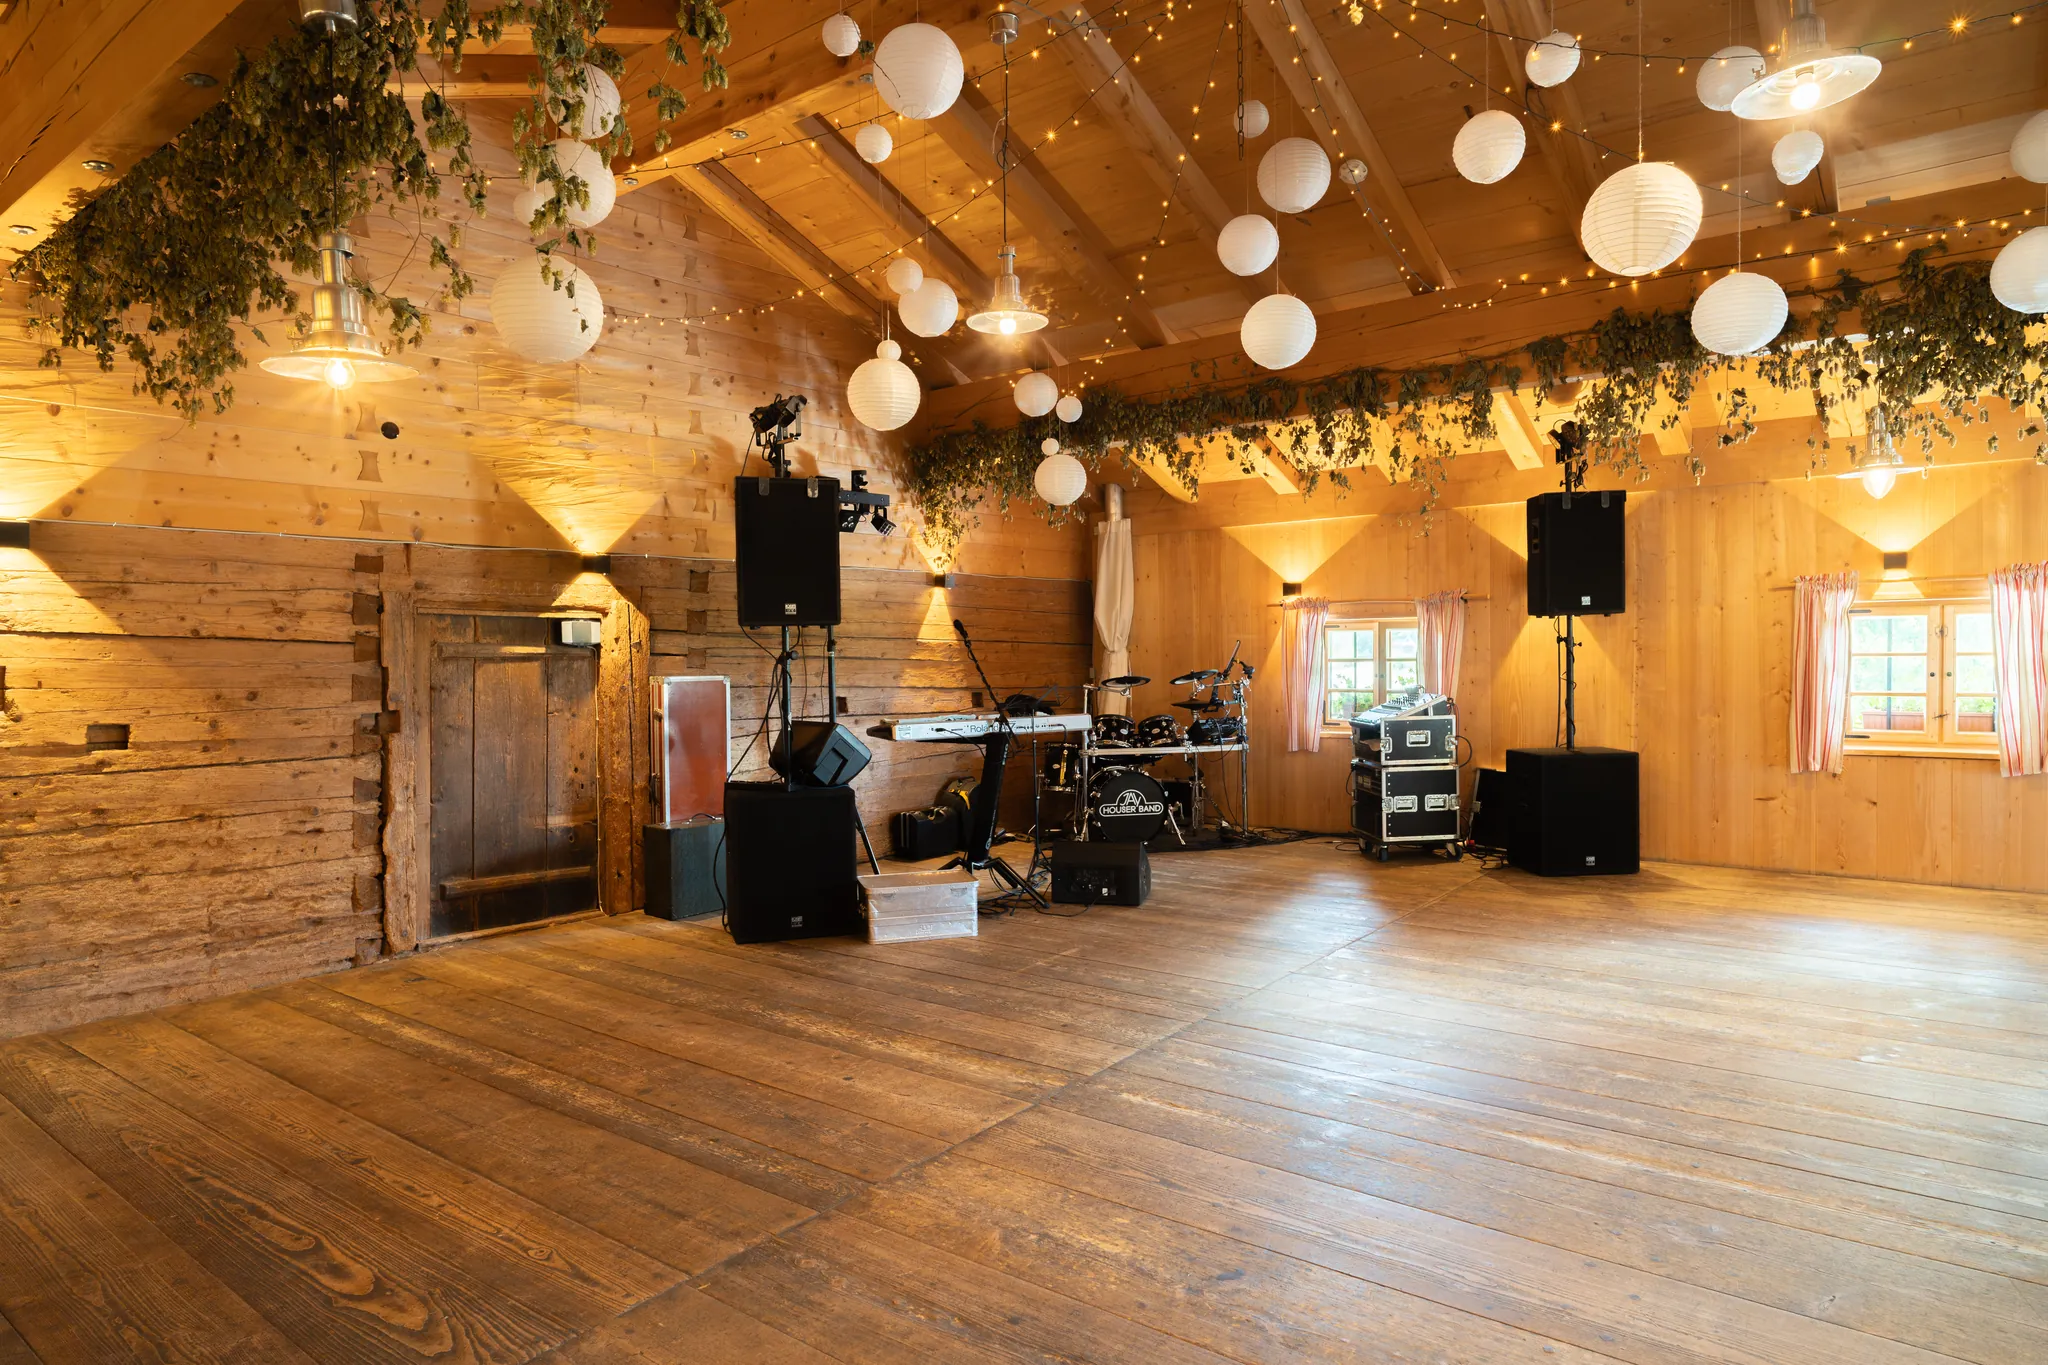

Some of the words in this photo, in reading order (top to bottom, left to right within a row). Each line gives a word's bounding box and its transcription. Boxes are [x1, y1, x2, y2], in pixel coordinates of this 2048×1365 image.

[970, 724, 998, 732] Roland
[1120, 792, 1141, 806] JAY
[1103, 805, 1136, 814] HOUSER
[1138, 804, 1161, 812] BAND
